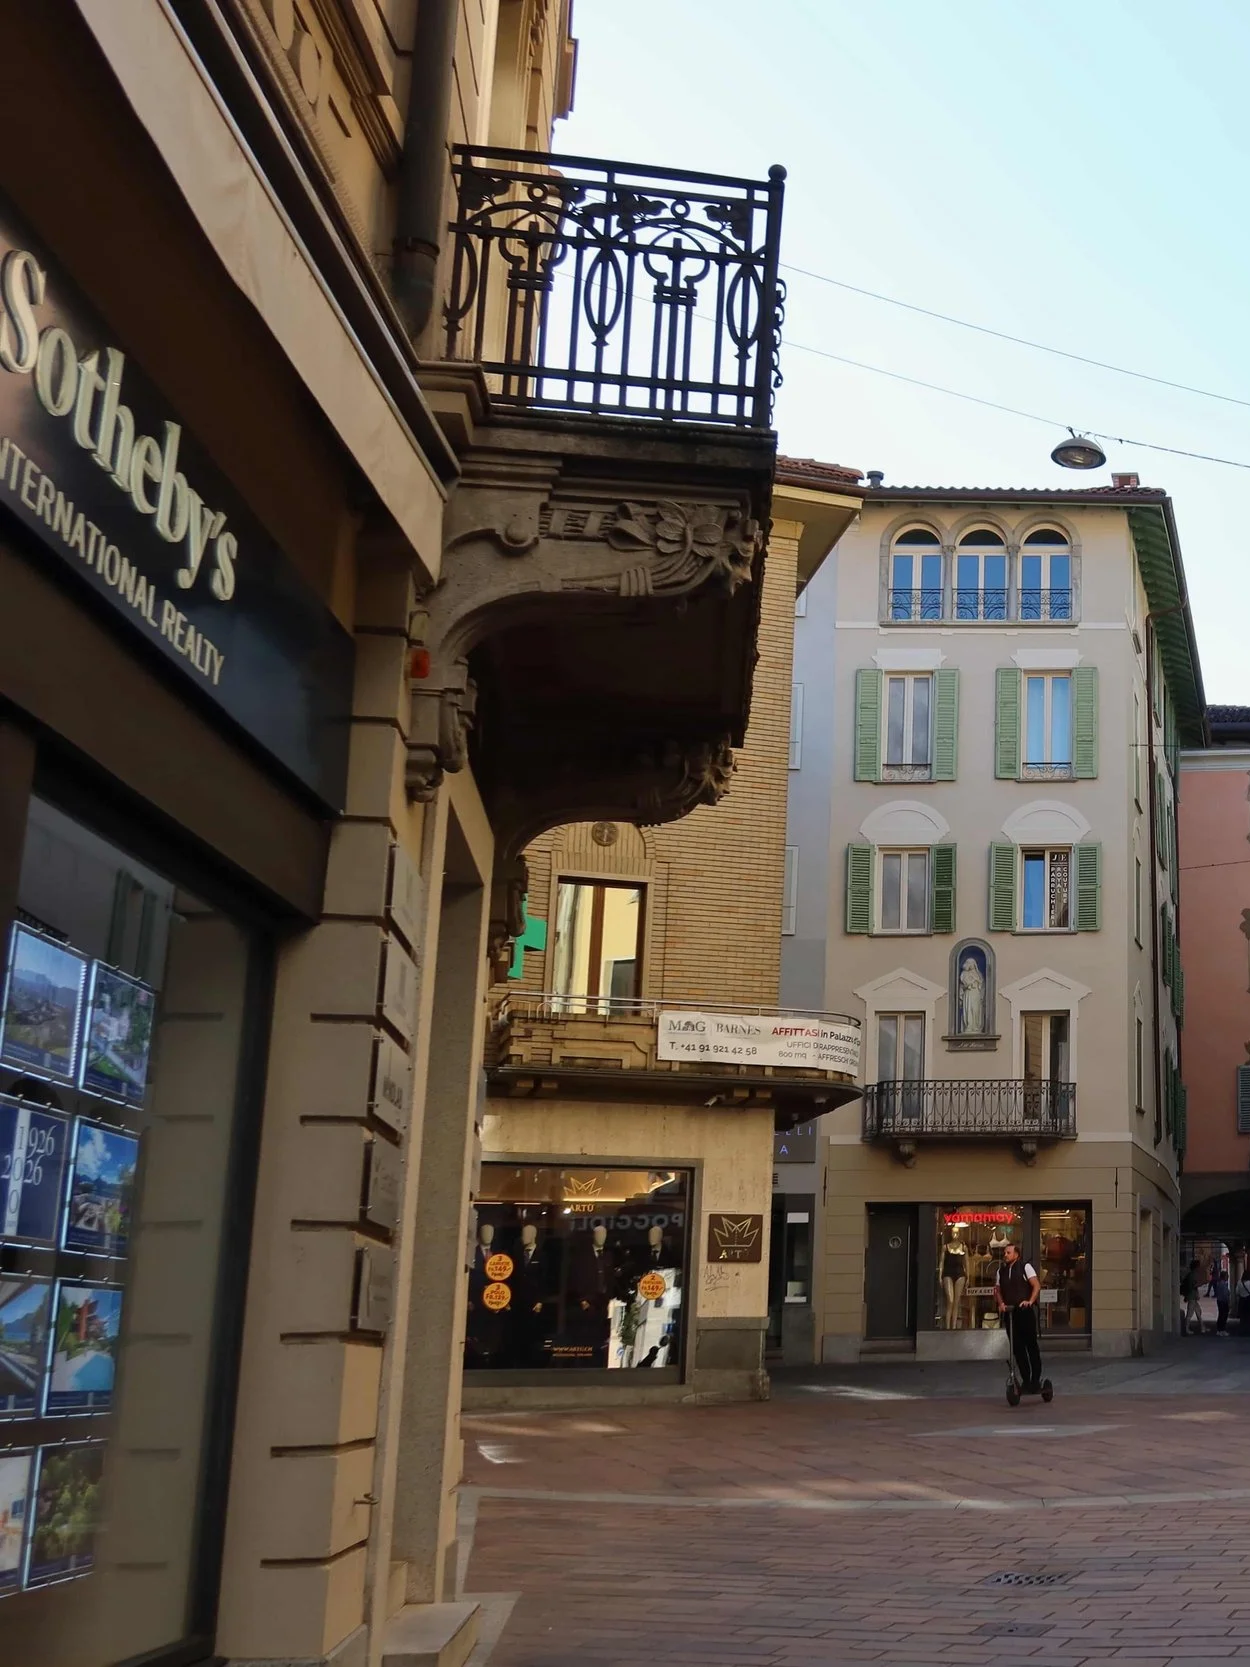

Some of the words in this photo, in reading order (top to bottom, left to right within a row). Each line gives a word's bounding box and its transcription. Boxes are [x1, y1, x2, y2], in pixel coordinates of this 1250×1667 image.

[0, 249, 238, 601] Sotheby's
[161, 599, 224, 686] REALTY
[715, 1022, 761, 1036] BARNES
[771, 1026, 820, 1038] AFFITTASI
[820, 1029, 829, 1039] in
[668, 1041, 679, 1050] T.
[681, 1043, 697, 1052] +41
[698, 1043, 711, 1053] 91
[713, 1044, 729, 1054] 921
[731, 1046, 744, 1055] 42
[745, 1046, 758, 1056] 58
[786, 1041, 812, 1050] UFFICI
[778, 1050, 793, 1058] 800
[794, 1052, 807, 1060] mq
[943, 1212, 1014, 1224] yamamay
